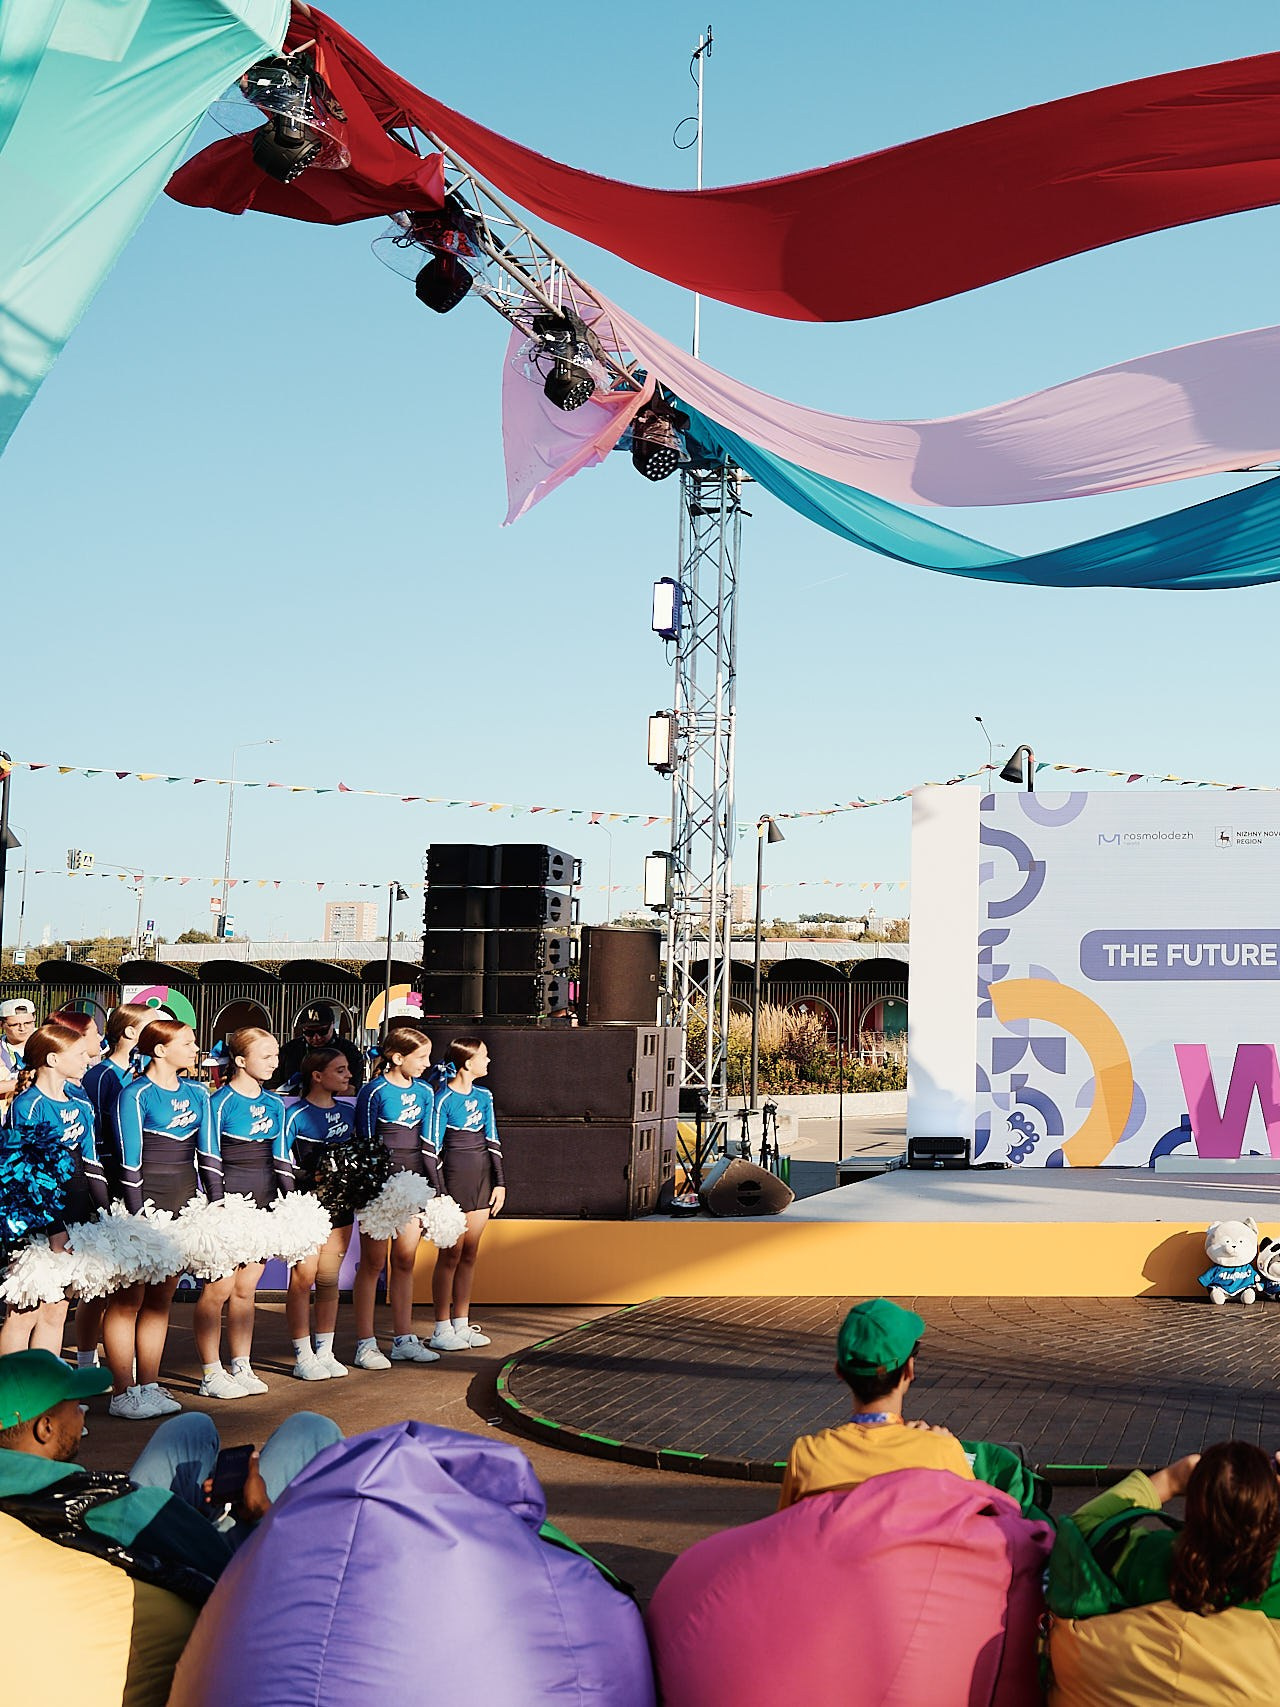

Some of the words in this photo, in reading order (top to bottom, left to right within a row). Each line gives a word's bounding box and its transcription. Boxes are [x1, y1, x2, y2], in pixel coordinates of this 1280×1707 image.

[1123, 831, 1194, 840] rosmolodezh
[1103, 944, 1158, 967] THE
[1167, 943, 1278, 967] FUTURE
